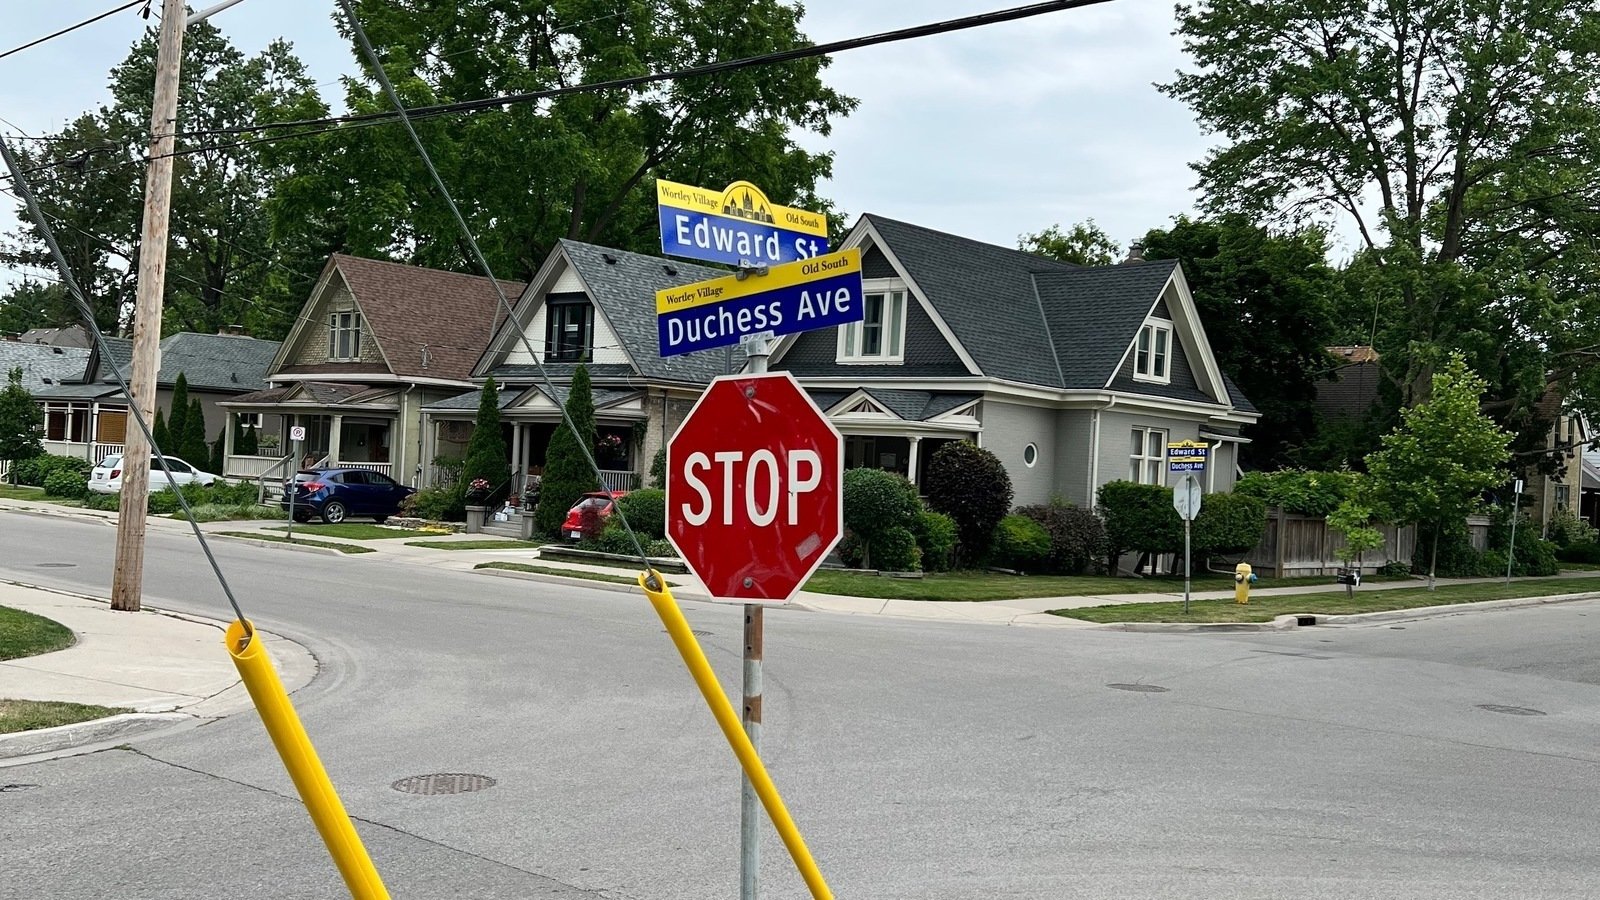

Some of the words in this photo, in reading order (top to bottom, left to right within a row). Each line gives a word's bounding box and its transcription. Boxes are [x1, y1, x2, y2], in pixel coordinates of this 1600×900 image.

[661, 186, 692, 204] Wortley
[693, 192, 719, 209] Village
[786, 213, 800, 225] Old
[800, 217, 819, 230] South
[675, 214, 781, 261] Edward
[795, 238, 819, 262] St
[802, 261, 820, 275] Old
[821, 257, 849, 272] South
[666, 293, 696, 305] Wortley
[697, 286, 724, 299] Village
[668, 301, 783, 347] Duchess
[797, 287, 851, 321] Ave
[681, 448, 823, 527] STOP
